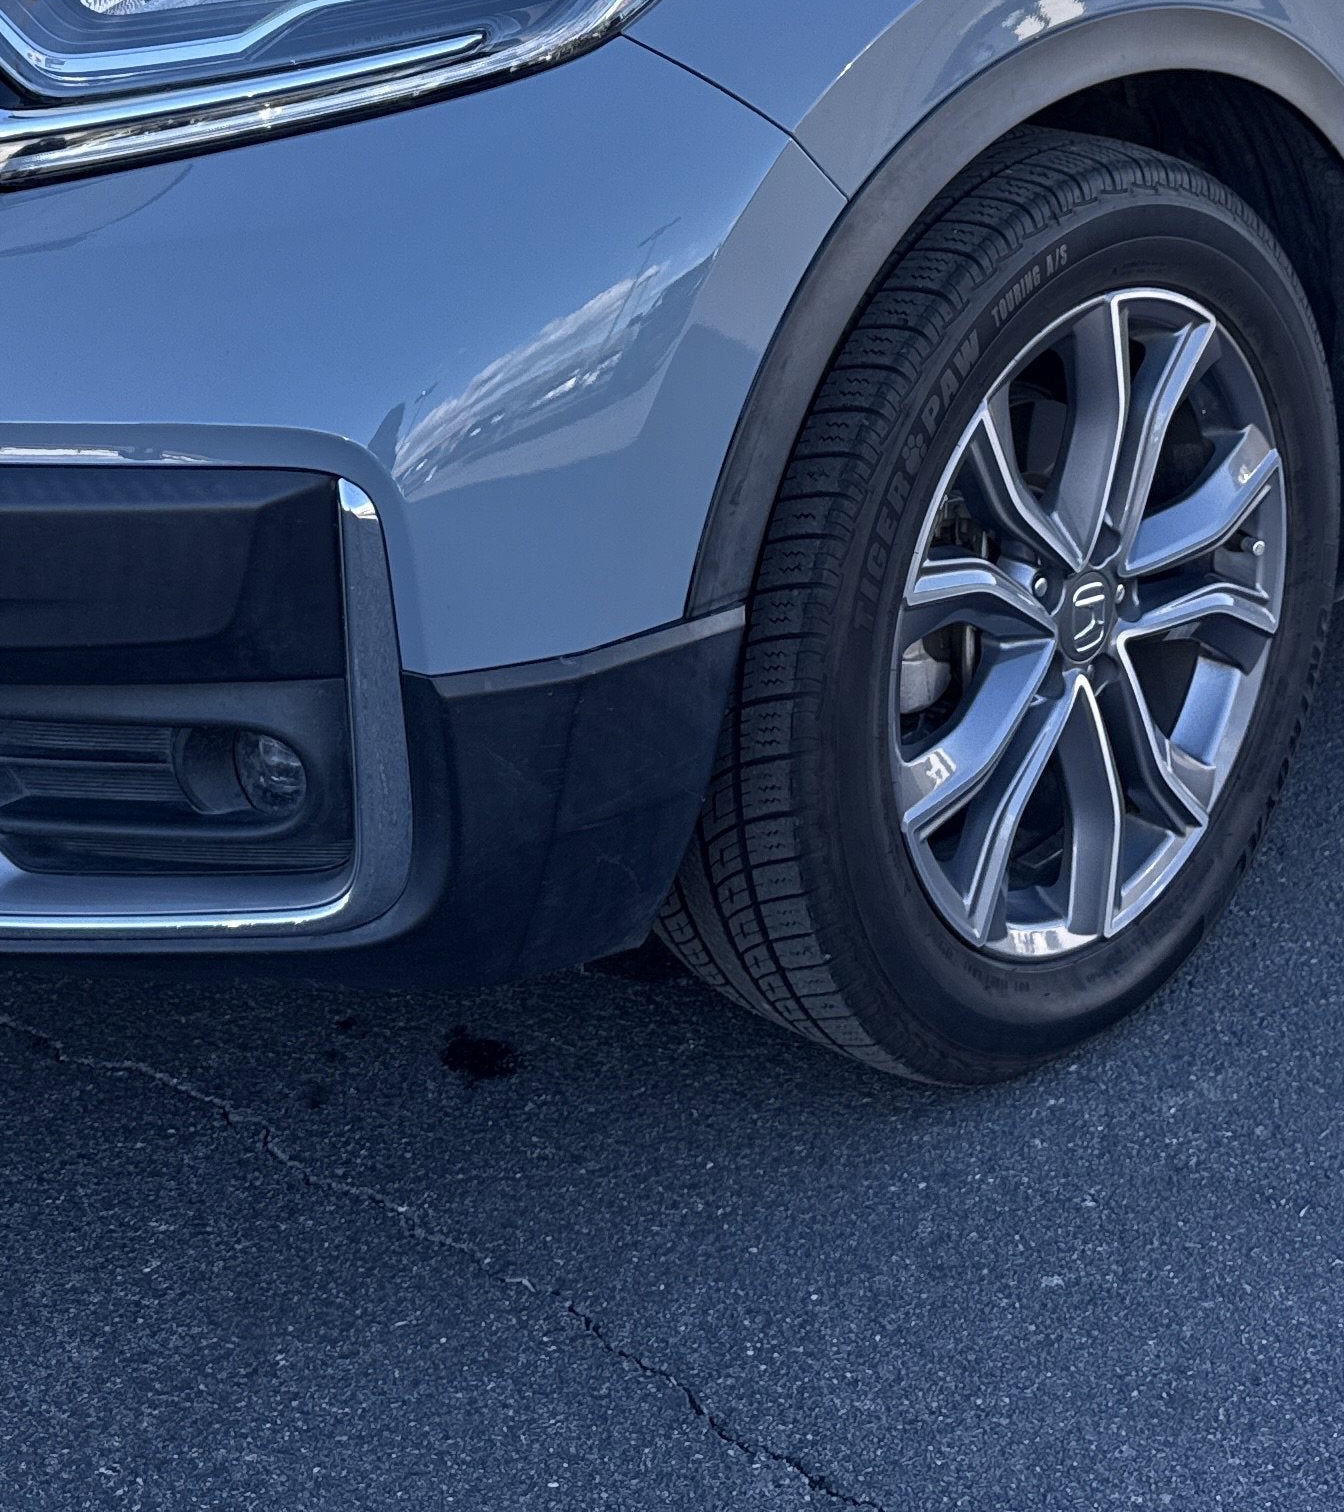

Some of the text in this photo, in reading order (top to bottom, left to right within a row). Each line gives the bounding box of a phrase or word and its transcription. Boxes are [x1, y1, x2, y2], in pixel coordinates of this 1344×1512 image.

[853, 243, 1069, 631] TIGER PAW TOURING A/S
